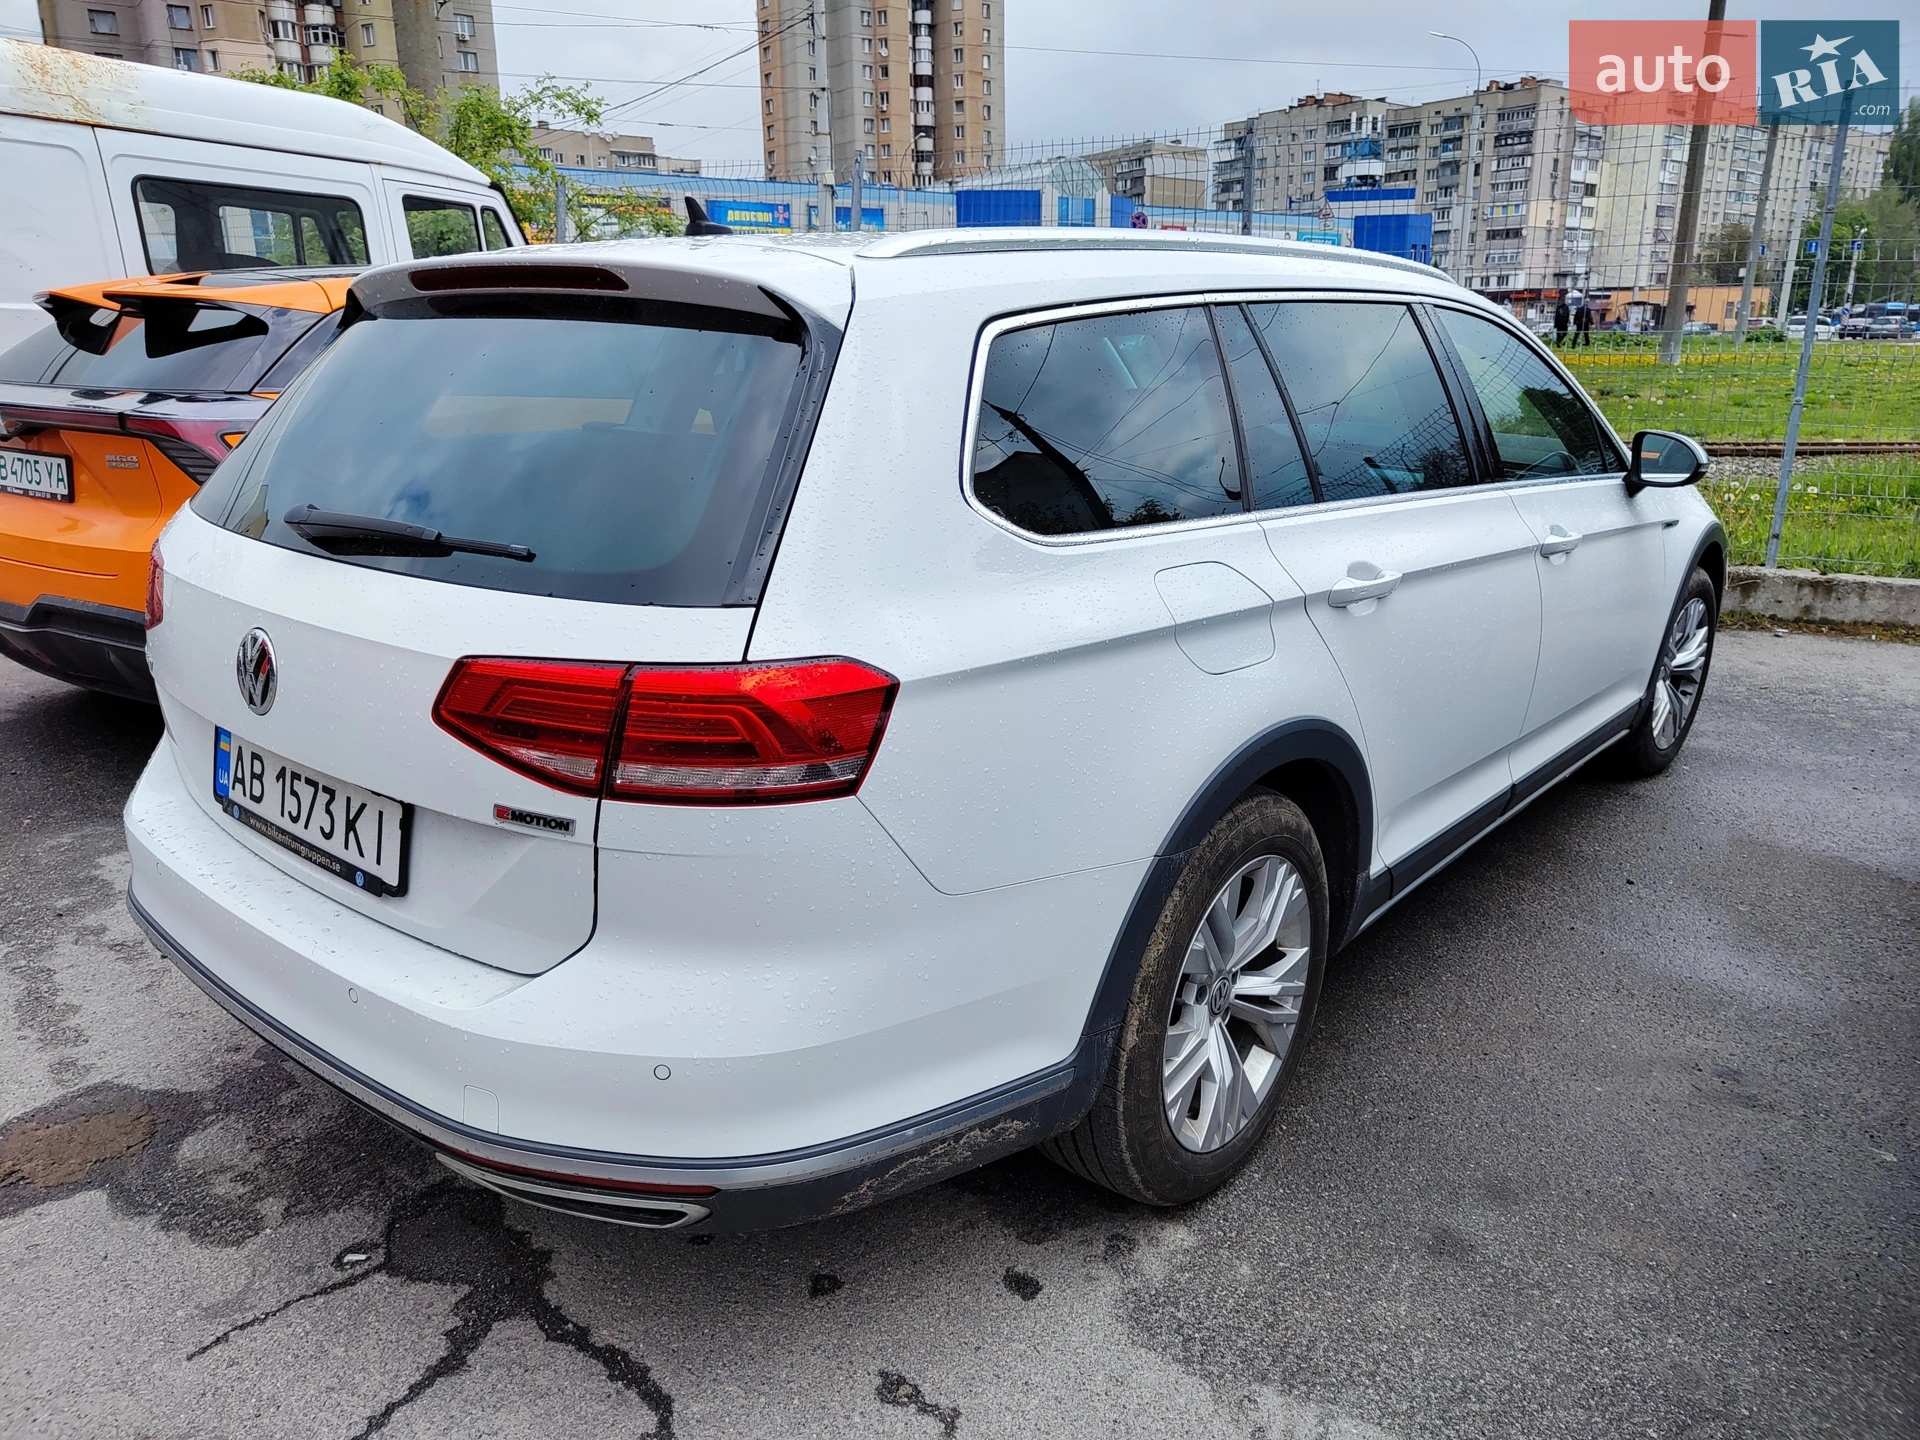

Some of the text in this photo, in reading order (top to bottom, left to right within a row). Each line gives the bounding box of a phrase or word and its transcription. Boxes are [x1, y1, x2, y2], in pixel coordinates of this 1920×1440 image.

[10, 457, 42, 486] 4705
[44, 461, 67, 490] YA
[218, 768, 229, 787] UA
[231, 745, 384, 866] AB 1573 KI
[249, 816, 341, 873] www.bilcentrumgruppen.se
